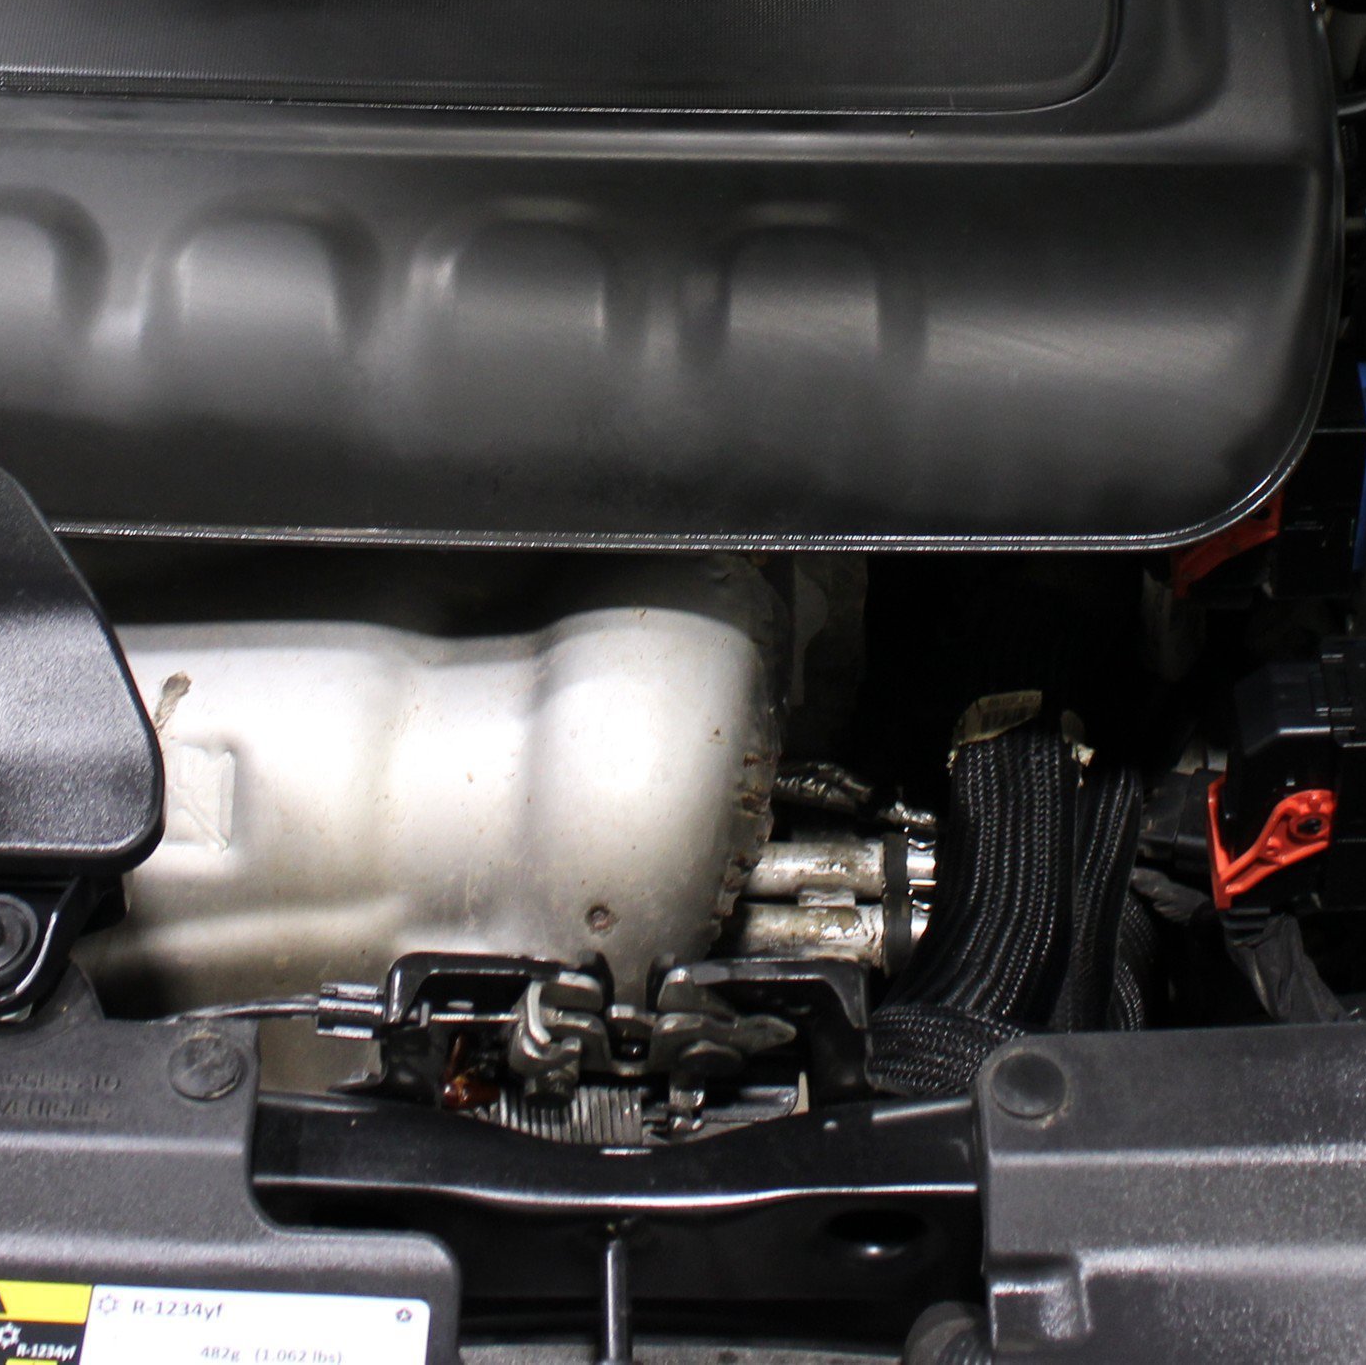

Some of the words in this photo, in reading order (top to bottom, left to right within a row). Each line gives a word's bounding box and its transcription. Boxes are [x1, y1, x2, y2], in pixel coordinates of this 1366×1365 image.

[132, 1299, 224, 1321] R-1234yf
[15, 1342, 77, 1363] R-1234yf
[200, 1346, 241, 1363] 482g
[254, 1347, 307, 1364] (1.062
